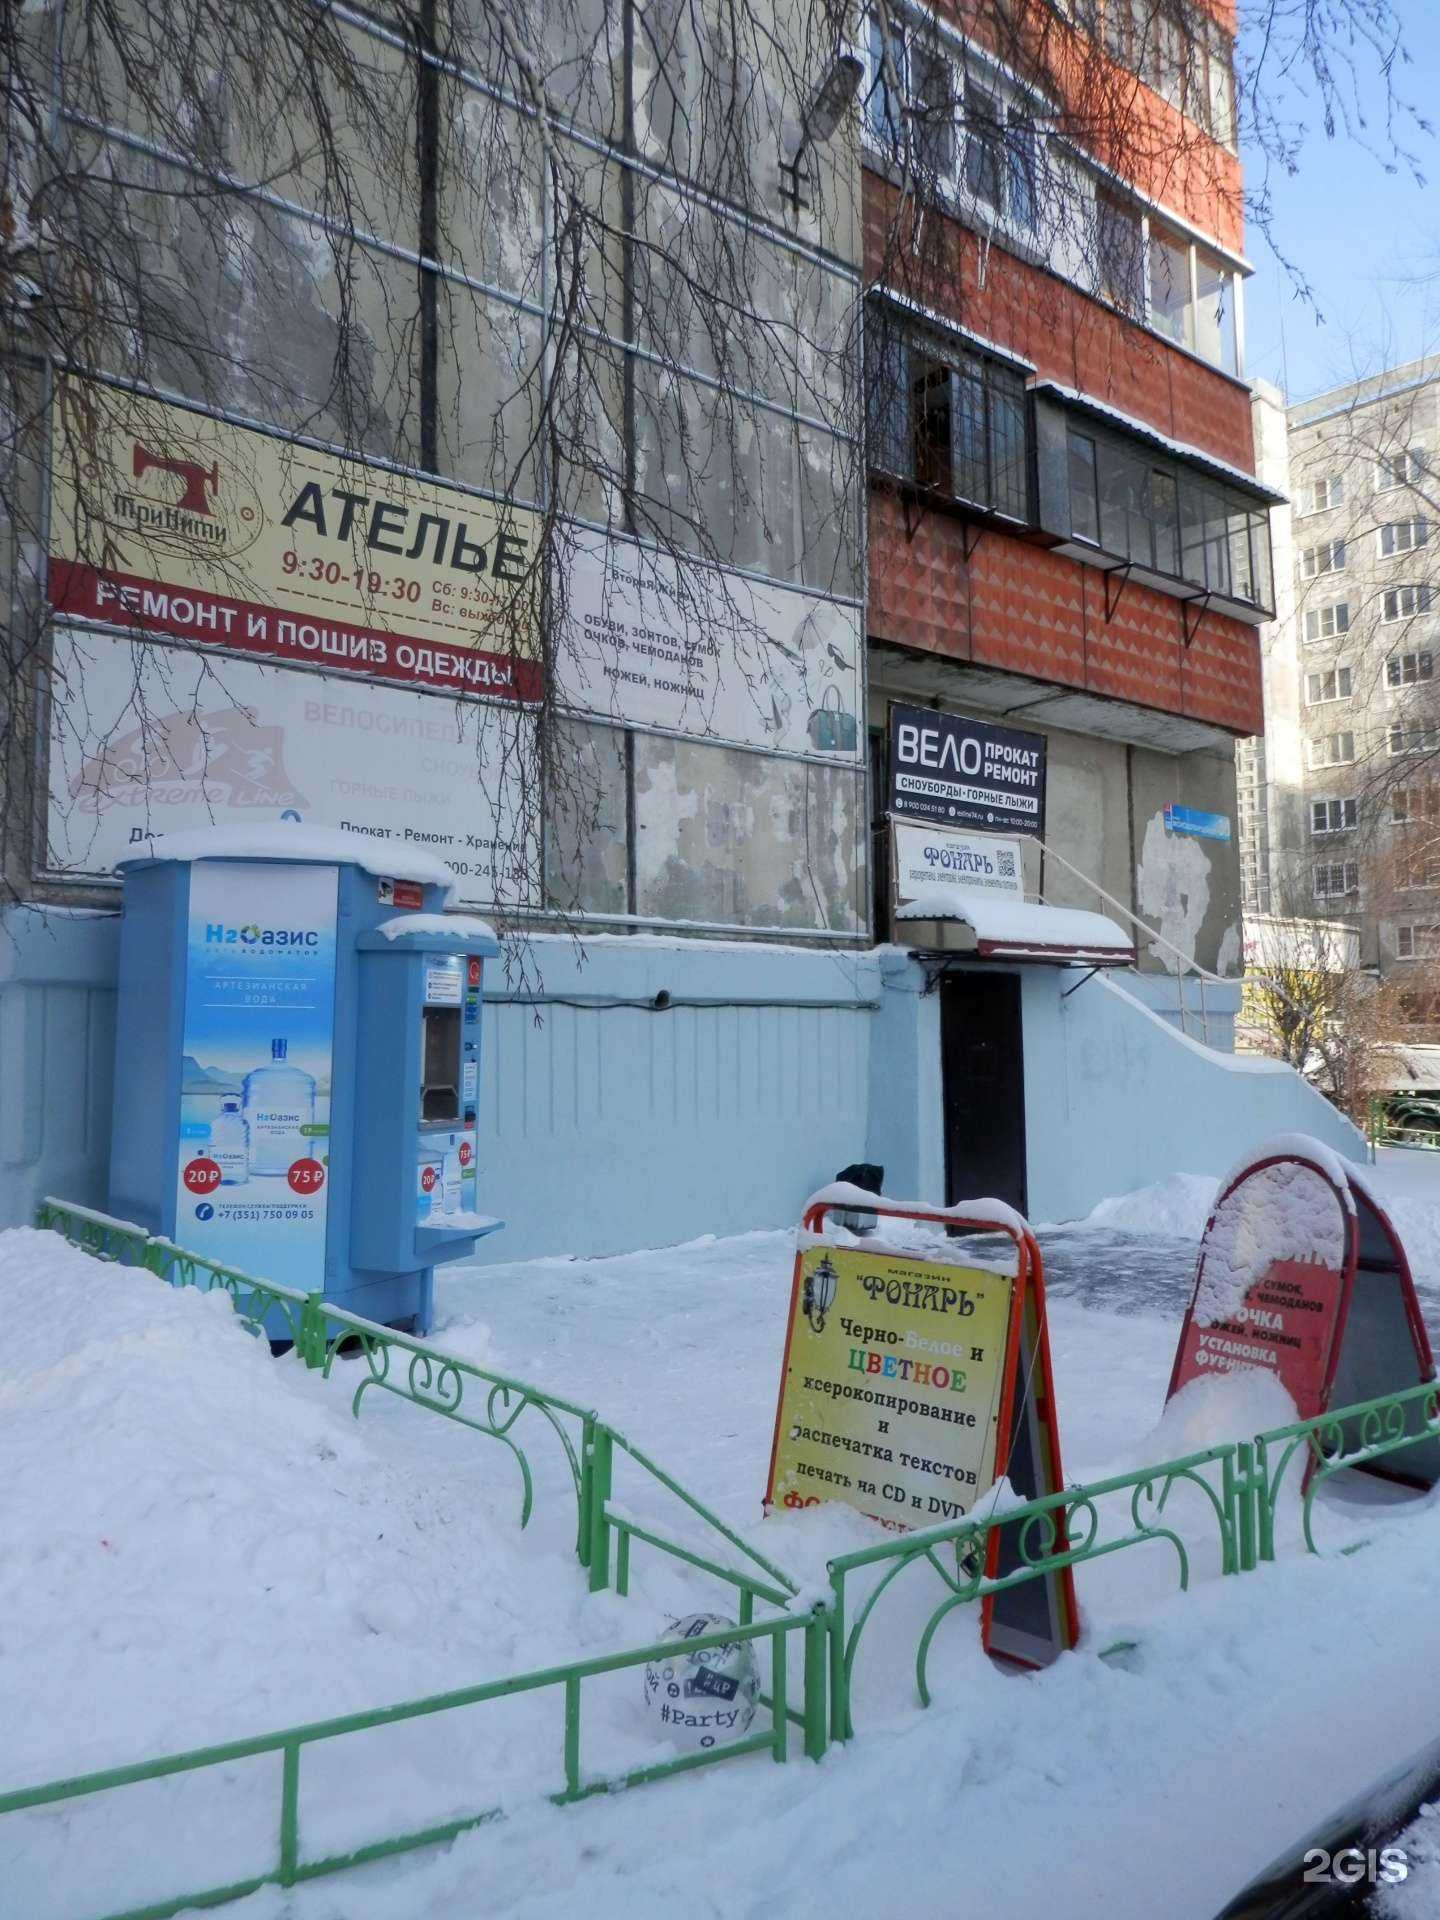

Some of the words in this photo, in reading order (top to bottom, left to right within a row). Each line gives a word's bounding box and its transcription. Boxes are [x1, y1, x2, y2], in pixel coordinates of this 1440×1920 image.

[280, 481, 529, 583] АТЕЛЬЕ
[282, 550, 422, 603] 9:30-19:30
[432, 581, 455, 597] Сб:
[432, 598, 455, 615] Вс:
[96, 581, 238, 633] РЕМОНТ
[247, 613, 267, 640] И
[278, 620, 389, 664] ПОШИВ
[396, 644, 513, 687] ОДЕЖДЫ
[632, 642, 704, 668] ЧЕМОДАНОВ
[654, 679, 705, 701] НОЖНИЦ
[898, 724, 982, 775] ВЕЛО
[984, 742, 1039, 768] ПРОКАТ
[984, 762, 1038, 787] РЕМОНТ
[901, 777, 962, 797] СНОУБОРДЫ
[967, 789, 1003, 805] ГОРНЫЕ
[1005, 795, 1034, 811] ЛЫЖИ
[404, 828, 455, 845] Ремонт
[923, 847, 993, 874] ФОНАРЬ
[232, 1210, 260, 1221] (351)
[263, 1210, 283, 1220] 750
[285, 1210, 299, 1220] 09
[887, 1268, 951, 1282] магазин
[1210, 1319, 1248, 1338] ОЖЕЙ,
[1236, 1306, 1284, 1331] ОЧКА
[970, 1347, 984, 1361] и
[1199, 1334, 1278, 1364] УСТАНОВКА
[848, 1348, 967, 1393] ЦВЕТНОЕ
[803, 1376, 977, 1428] ксерокопирование
[878, 1419, 890, 1434] и
[789, 1425, 893, 1462] распечатка
[899, 1453, 977, 1485] текстов
[796, 1462, 852, 1487] печать
[857, 1479, 876, 1496] на
[882, 1483, 906, 1504] CD
[911, 1495, 922, 1509] и
[660, 1703, 740, 1729] #Party
